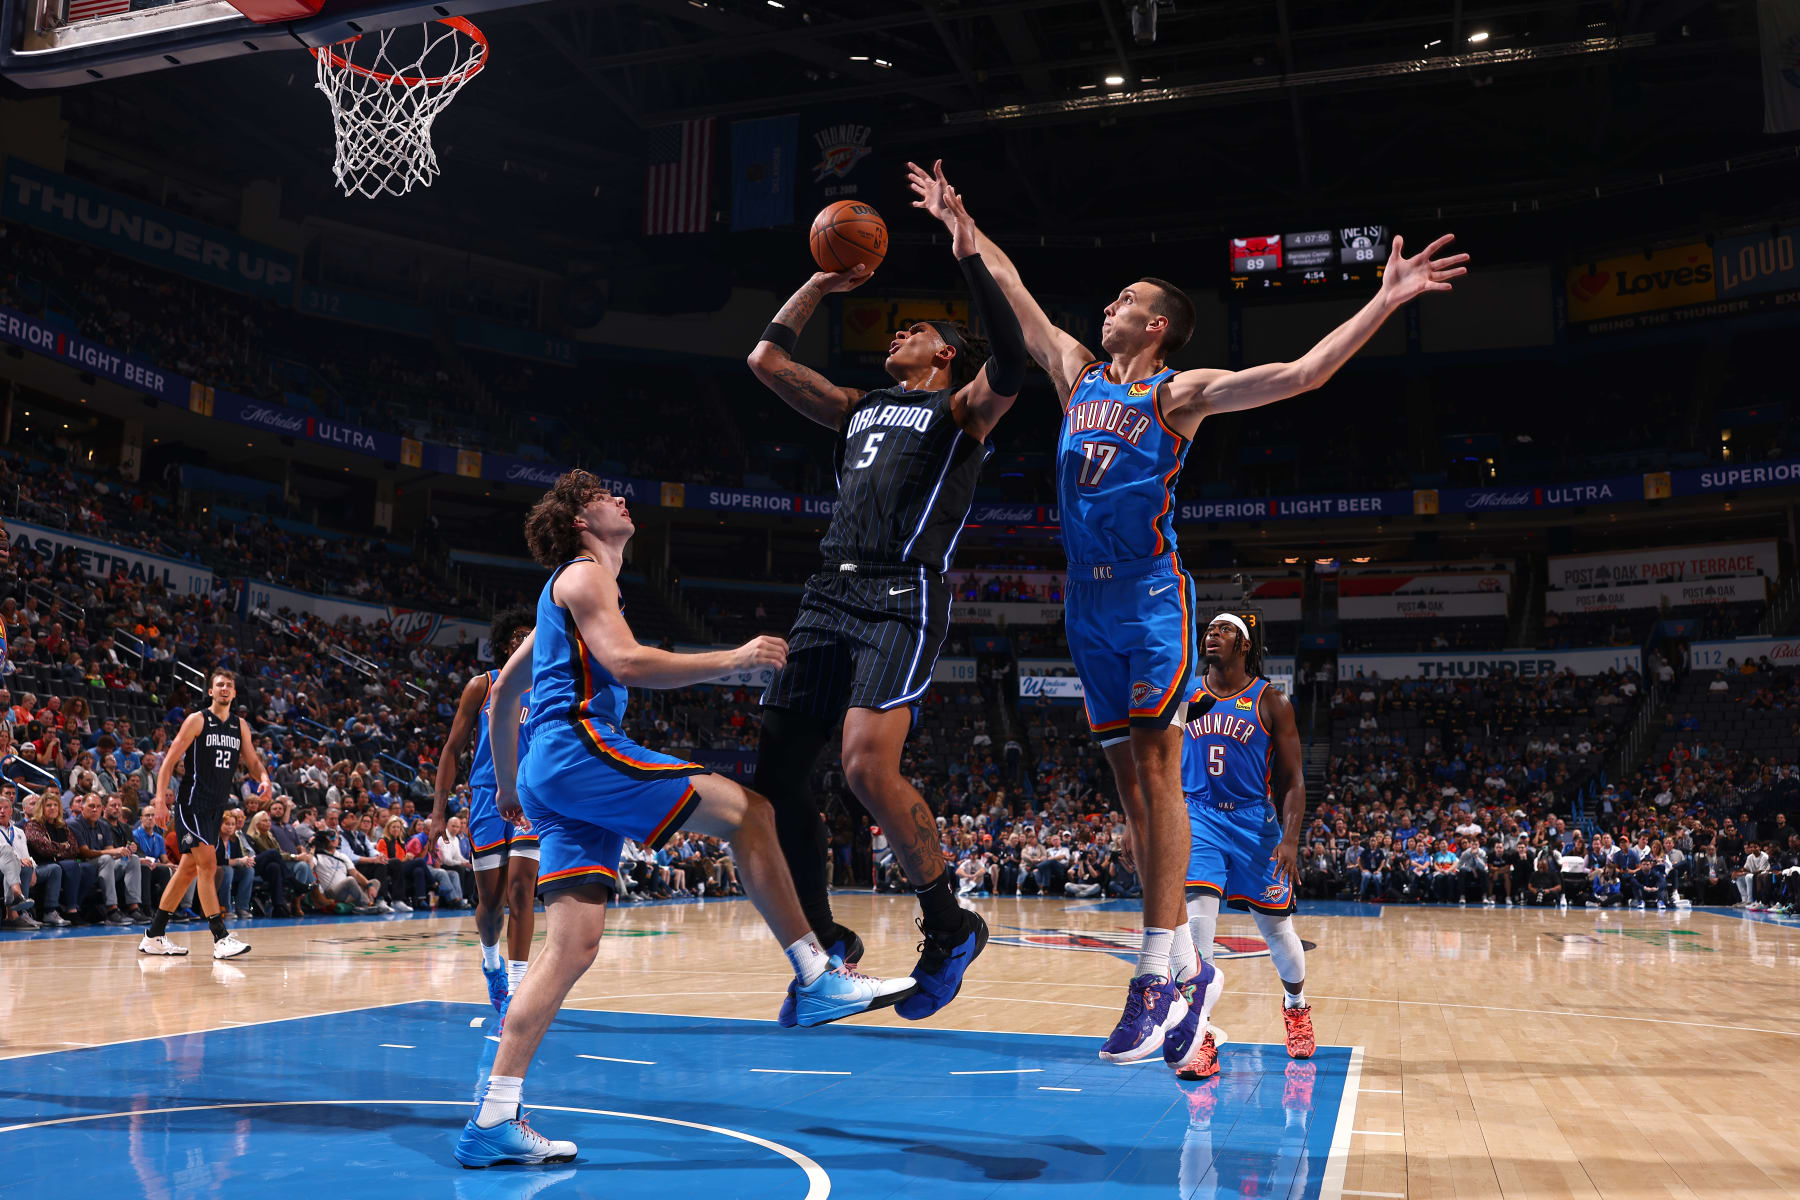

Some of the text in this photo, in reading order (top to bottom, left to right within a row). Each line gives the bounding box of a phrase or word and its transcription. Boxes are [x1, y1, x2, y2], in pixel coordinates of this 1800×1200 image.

[813, 123, 872, 150] THUNDER
[10, 174, 293, 286] THUNDER UP
[1247, 259, 1265, 271] 89
[1356, 249, 1374, 261] 88
[1721, 234, 1796, 294] LOUD
[1234, 281, 1245, 289] 71
[1264, 279, 1270, 288] 2
[1304, 271, 1325, 280] 4:54
[68, 339, 121, 376] LIGHT
[123, 362, 165, 392] BEER
[240, 405, 377, 451] Michelob ULTRA
[847, 404, 934, 440] ORLANDO
[1068, 400, 1152, 446] THUNDER
[855, 432, 887, 469] 5
[1078, 441, 1119, 488] 17
[709, 491, 792, 512] SUPERIOR
[1464, 484, 1613, 509] Michelob ULTRA
[1181, 498, 1383, 520] SUPERIOR LIGHT BEER
[1093, 566, 1113, 580] OKC
[1564, 555, 1755, 584] POST OAK PARTY TERRACE
[189, 575, 209, 594] 107
[1683, 584, 1736, 599] POST OAK
[1397, 600, 1445, 613] POST OAK
[1576, 592, 1625, 606] POST OAK
[1418, 659, 1558, 677] THUNDER
[1615, 656, 1640, 671] 111
[1695, 651, 1722, 665] 112
[951, 666, 975, 679] 109
[1185, 713, 1256, 744] THUNDER
[206, 734, 241, 751] ORLANDO
[215, 749, 232, 769] 22
[1209, 744, 1226, 776] 5
